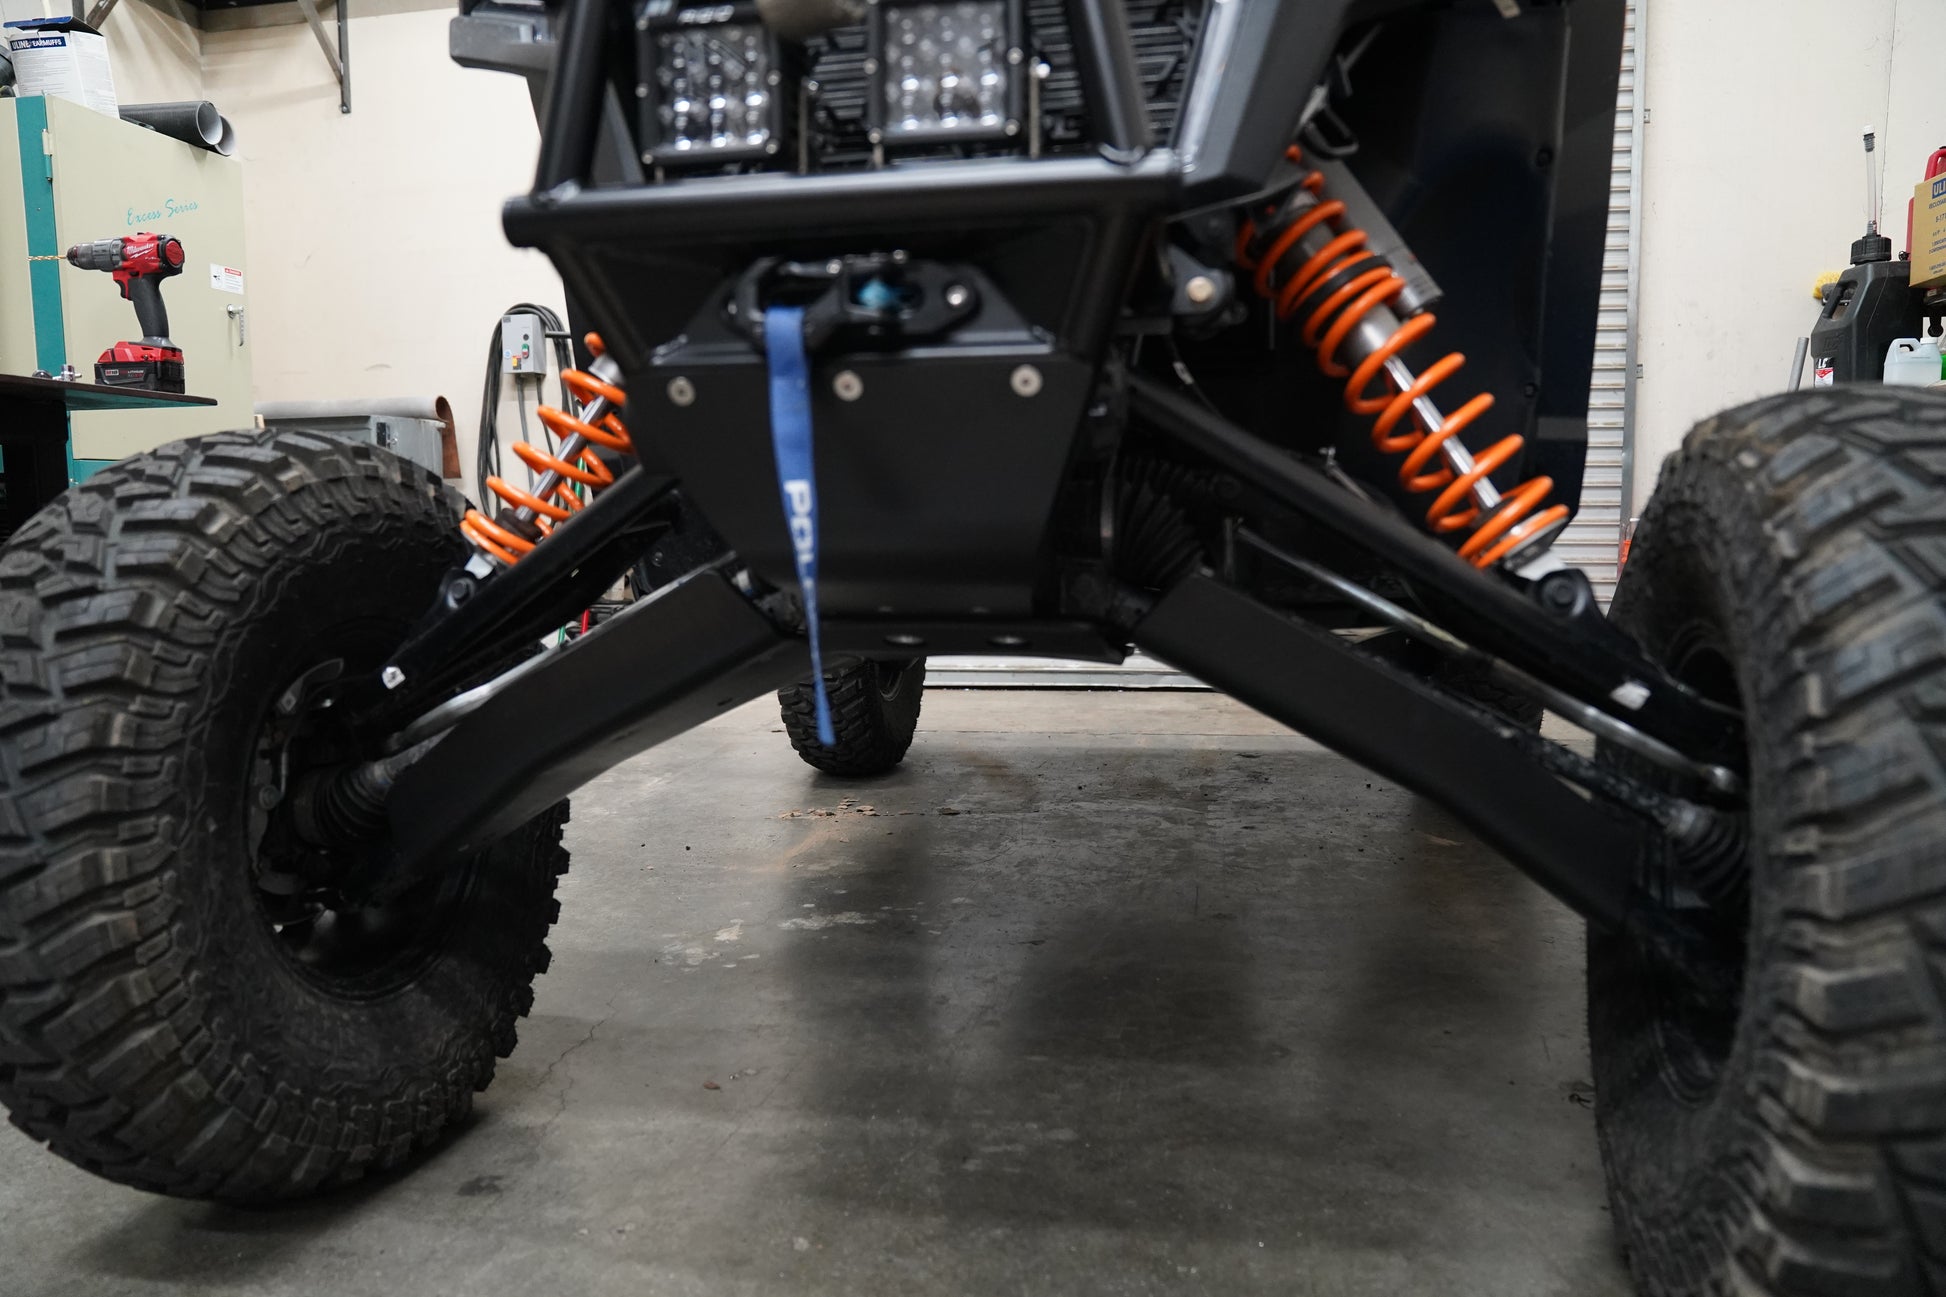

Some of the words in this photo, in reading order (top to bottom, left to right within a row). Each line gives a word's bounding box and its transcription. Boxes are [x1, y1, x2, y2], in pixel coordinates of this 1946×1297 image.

[1933, 180, 1946, 196] ULI
[127, 207, 162, 226] Excess
[164, 198, 199, 218] Series
